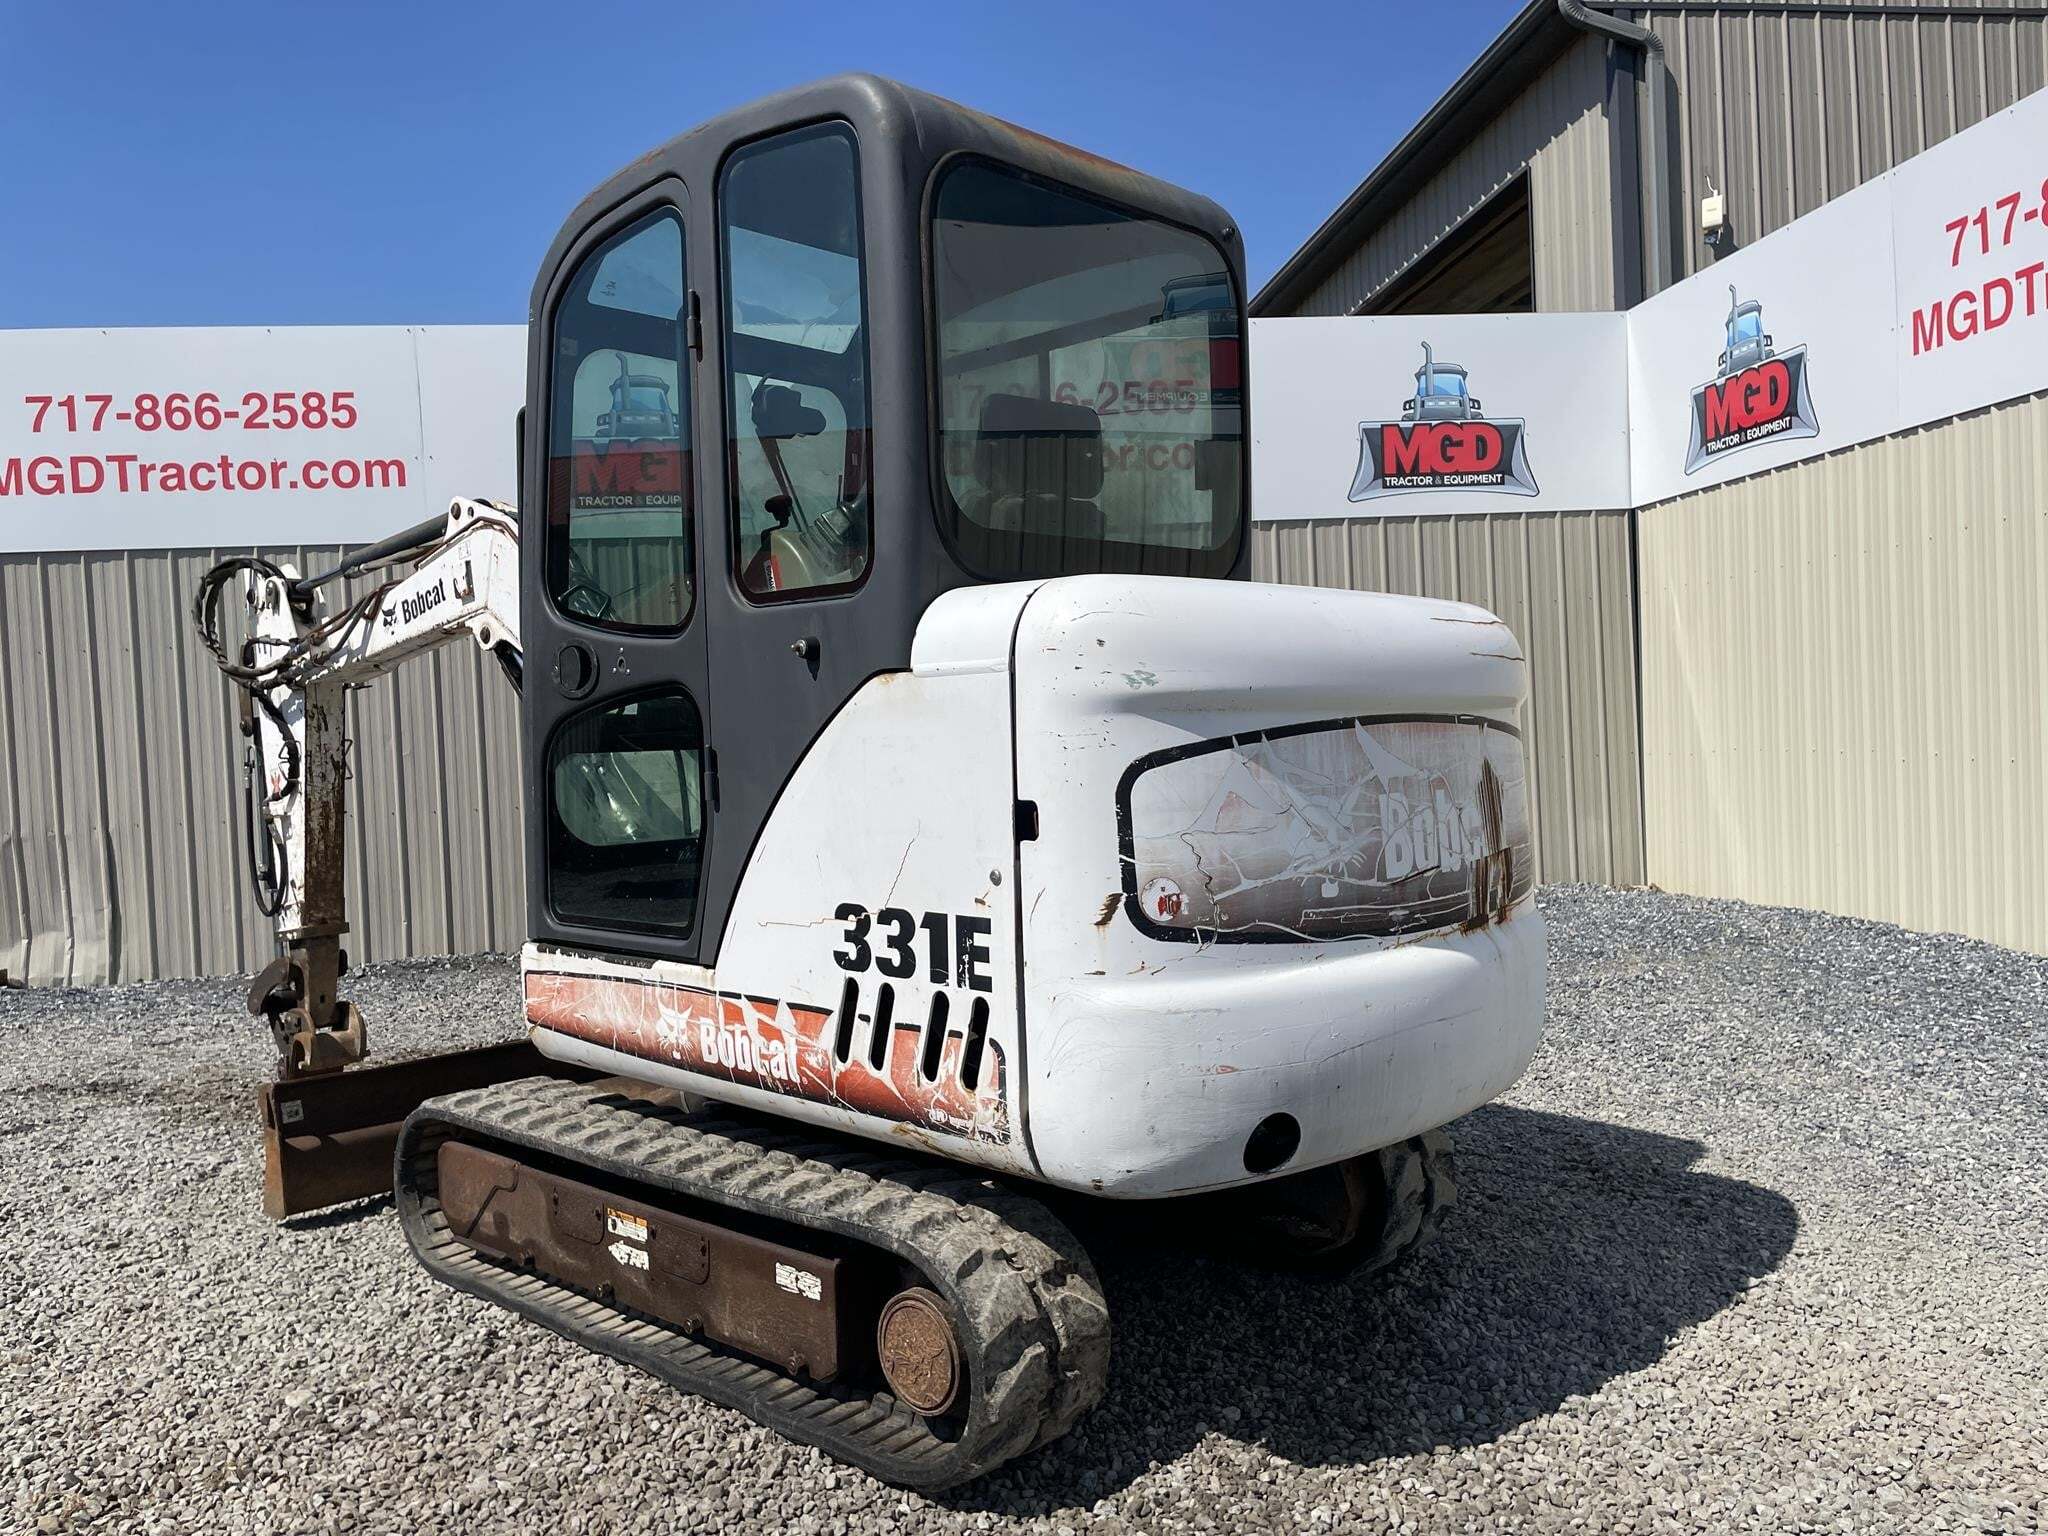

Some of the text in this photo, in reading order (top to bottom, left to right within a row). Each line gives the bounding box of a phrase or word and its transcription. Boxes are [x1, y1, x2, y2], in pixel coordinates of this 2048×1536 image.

[1912, 261, 2048, 356] MGDT
[25, 391, 358, 433] 717-866-2585
[1704, 359, 1791, 441] MGD
[1381, 421, 1504, 475] MGD
[1706, 433, 1740, 453] TRACTOR
[1746, 416, 1791, 440] EQUIPMENT
[0, 454, 407, 496] MGDTractor.com
[1384, 476, 1433, 486] TRACTOR
[1443, 473, 1503, 485] EQUIPMENT
[578, 496, 633, 506] TRACTOR
[401, 577, 446, 624] Bobcat
[833, 902, 993, 993] 331E
[699, 1015, 801, 1083] Bobcat
